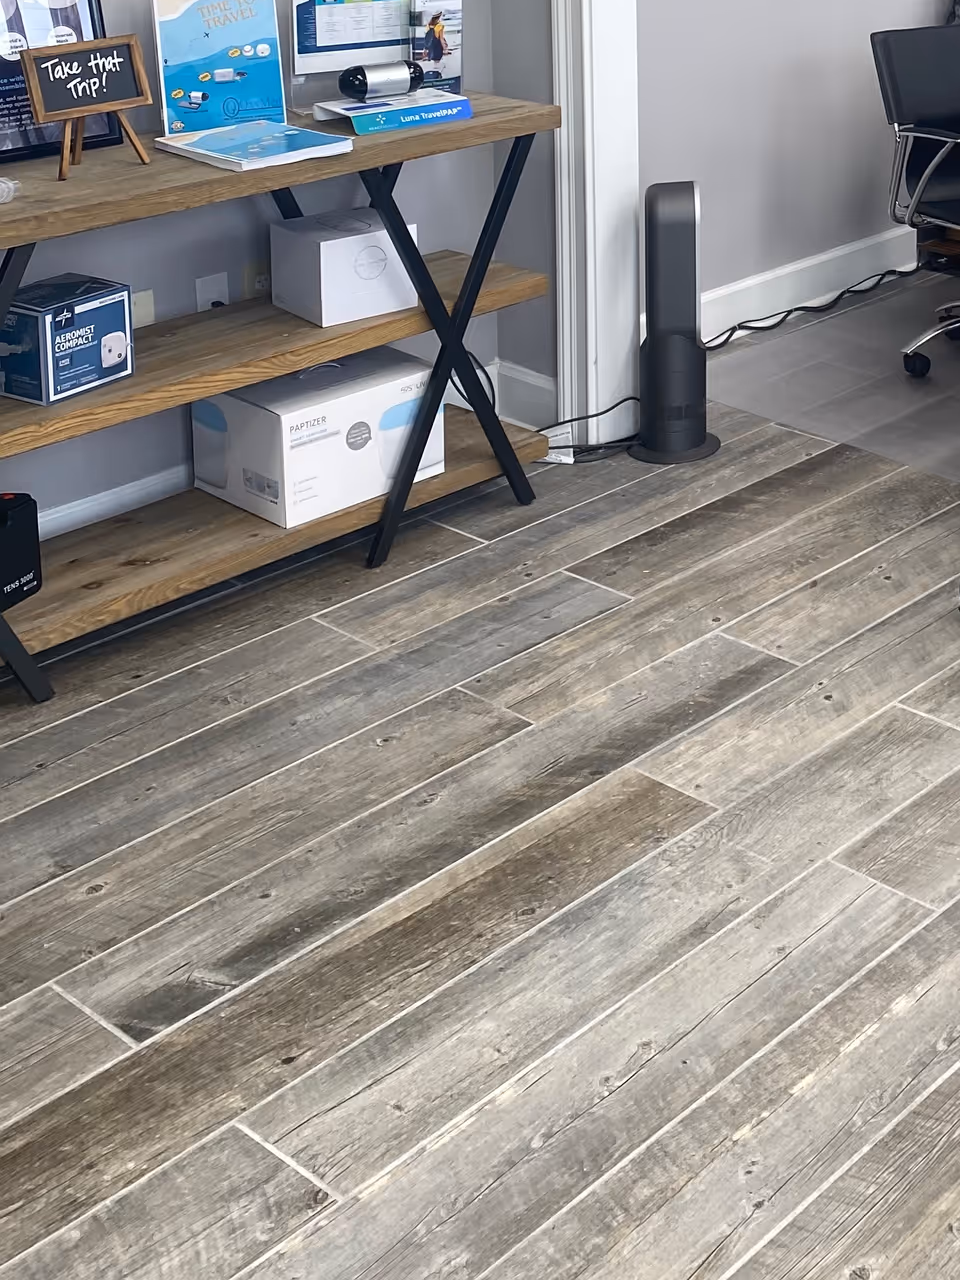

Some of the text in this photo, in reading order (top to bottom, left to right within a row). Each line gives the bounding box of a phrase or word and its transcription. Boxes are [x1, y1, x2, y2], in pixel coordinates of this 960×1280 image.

[197, 0, 232, 19] TIME
[203, 7, 258, 29] TRAVEL
[41, 50, 124, 81] Take that
[66, 71, 107, 99] Trip!
[401, 113, 420, 123] Luna
[55, 324, 95, 344] AEROMIST
[55, 333, 94, 352] COMPACT
[290, 415, 327, 433] PAPTIZER
[4, 580, 20, 594] TENS
